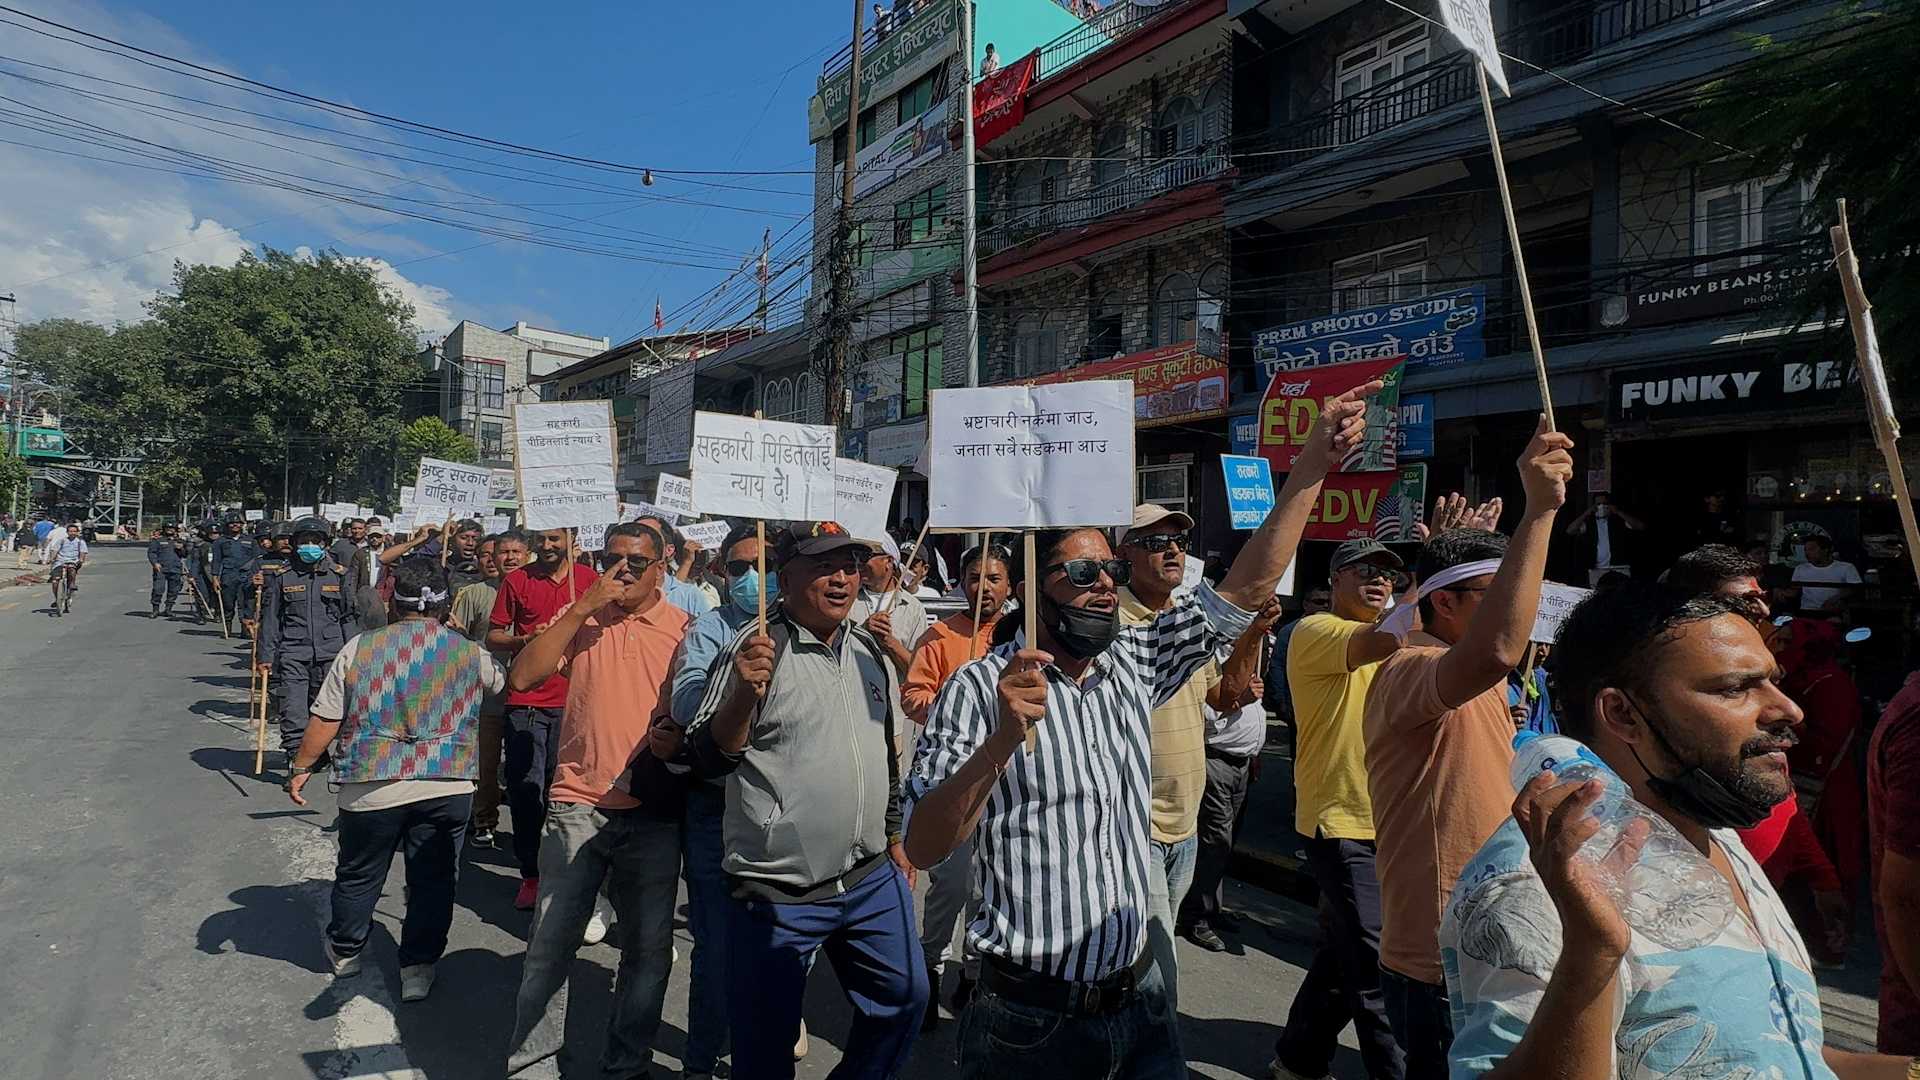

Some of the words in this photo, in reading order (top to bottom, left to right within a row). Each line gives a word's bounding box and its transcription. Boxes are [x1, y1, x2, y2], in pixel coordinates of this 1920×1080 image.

[857, 152, 886, 177] APITAL
[1638, 284, 1702, 306] FUNKY
[1708, 270, 1773, 294] BEANS
[1257, 328, 1308, 346] PREM
[1621, 370, 1762, 409] FUNKY
[545, 417, 581, 429] सहकारी
[963, 411, 1019, 429] भ्रष्टाचारी
[1020, 409, 1061, 429] नर्कमा
[1263, 395, 1334, 446] ED
[527, 434, 570, 447] पीडितलाई
[571, 436, 594, 445] न्याय
[953, 443, 991, 457] जनता
[994, 436, 1018, 457] सबै
[1077, 439, 1109, 454] आउ
[696, 431, 754, 463] सहकारी
[761, 433, 832, 472] पिडितलाई
[450, 468, 491, 487] सरकार
[541, 478, 574, 490] सहकारी
[425, 484, 468, 504] चाहिदैन
[730, 473, 767, 503] न्याय
